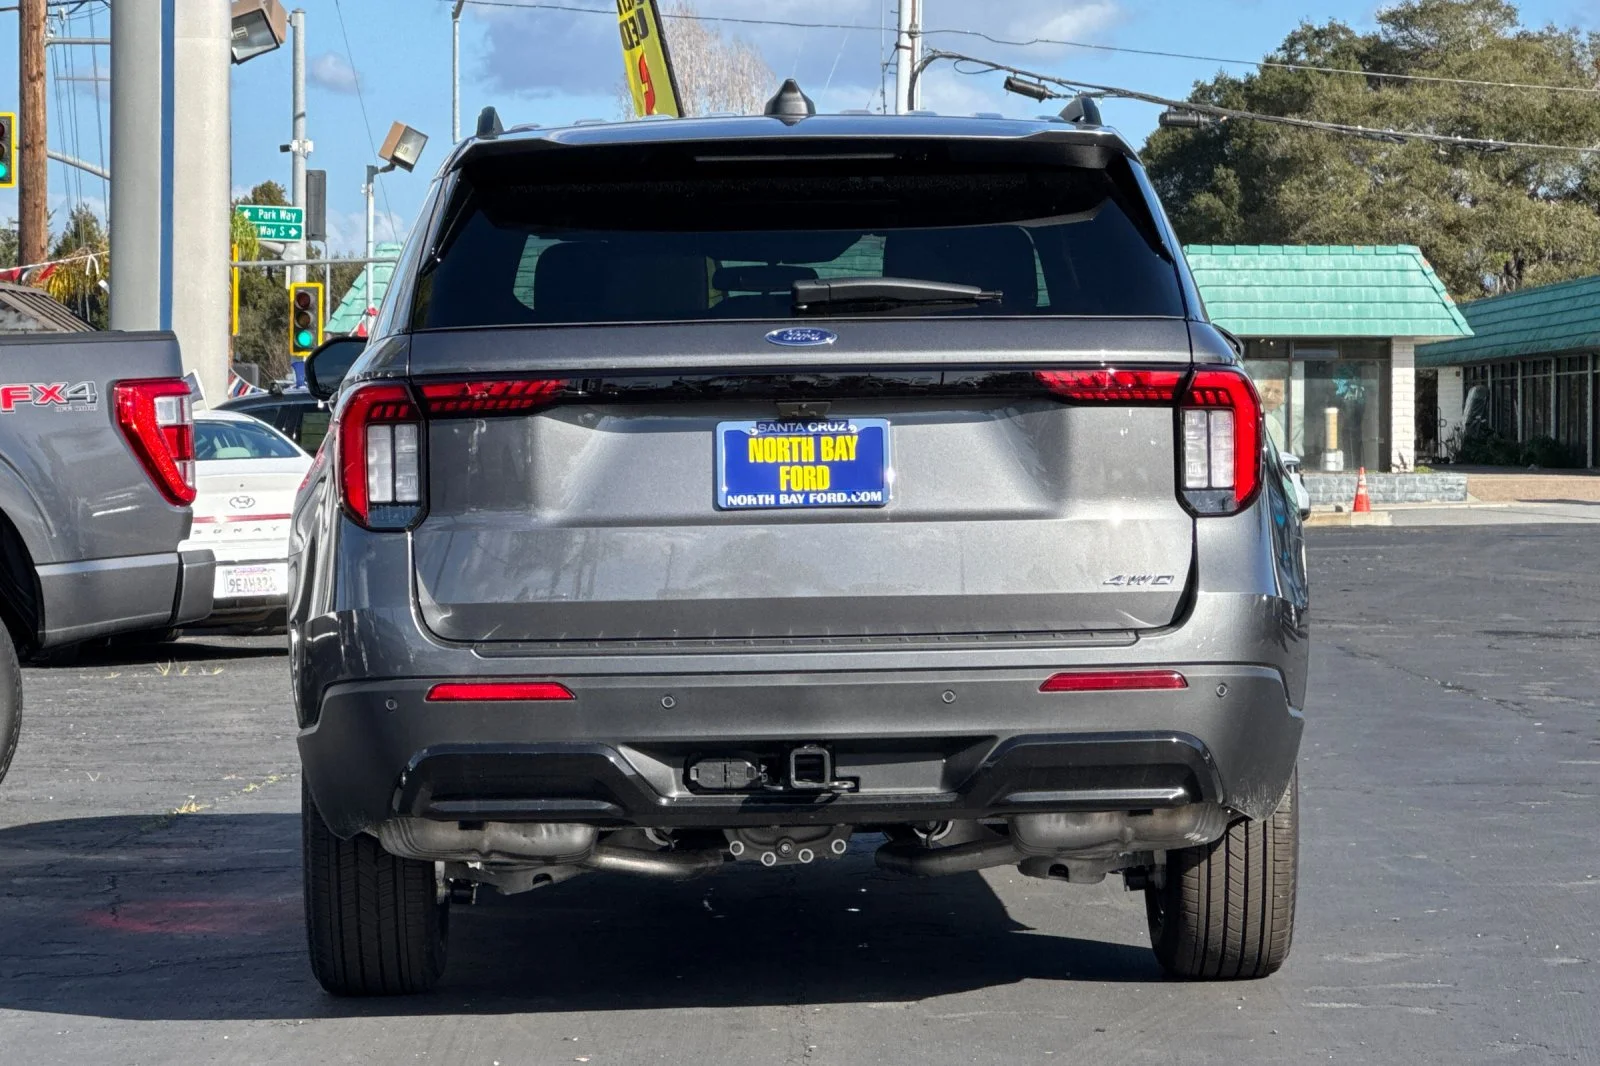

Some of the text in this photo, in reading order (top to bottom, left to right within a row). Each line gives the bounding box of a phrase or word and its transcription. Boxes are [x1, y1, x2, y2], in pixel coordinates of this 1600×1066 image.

[258, 209, 296, 222] Park Way
[260, 226, 285, 238] Way S
[0, 381, 98, 414] FX4
[758, 421, 848, 433] SANTA CRUZ
[748, 435, 858, 463] NORTH BAY
[779, 465, 831, 491] FORD
[727, 491, 882, 506] NORTH BAY FORD.COM
[1102, 574, 1175, 586] 4WD
